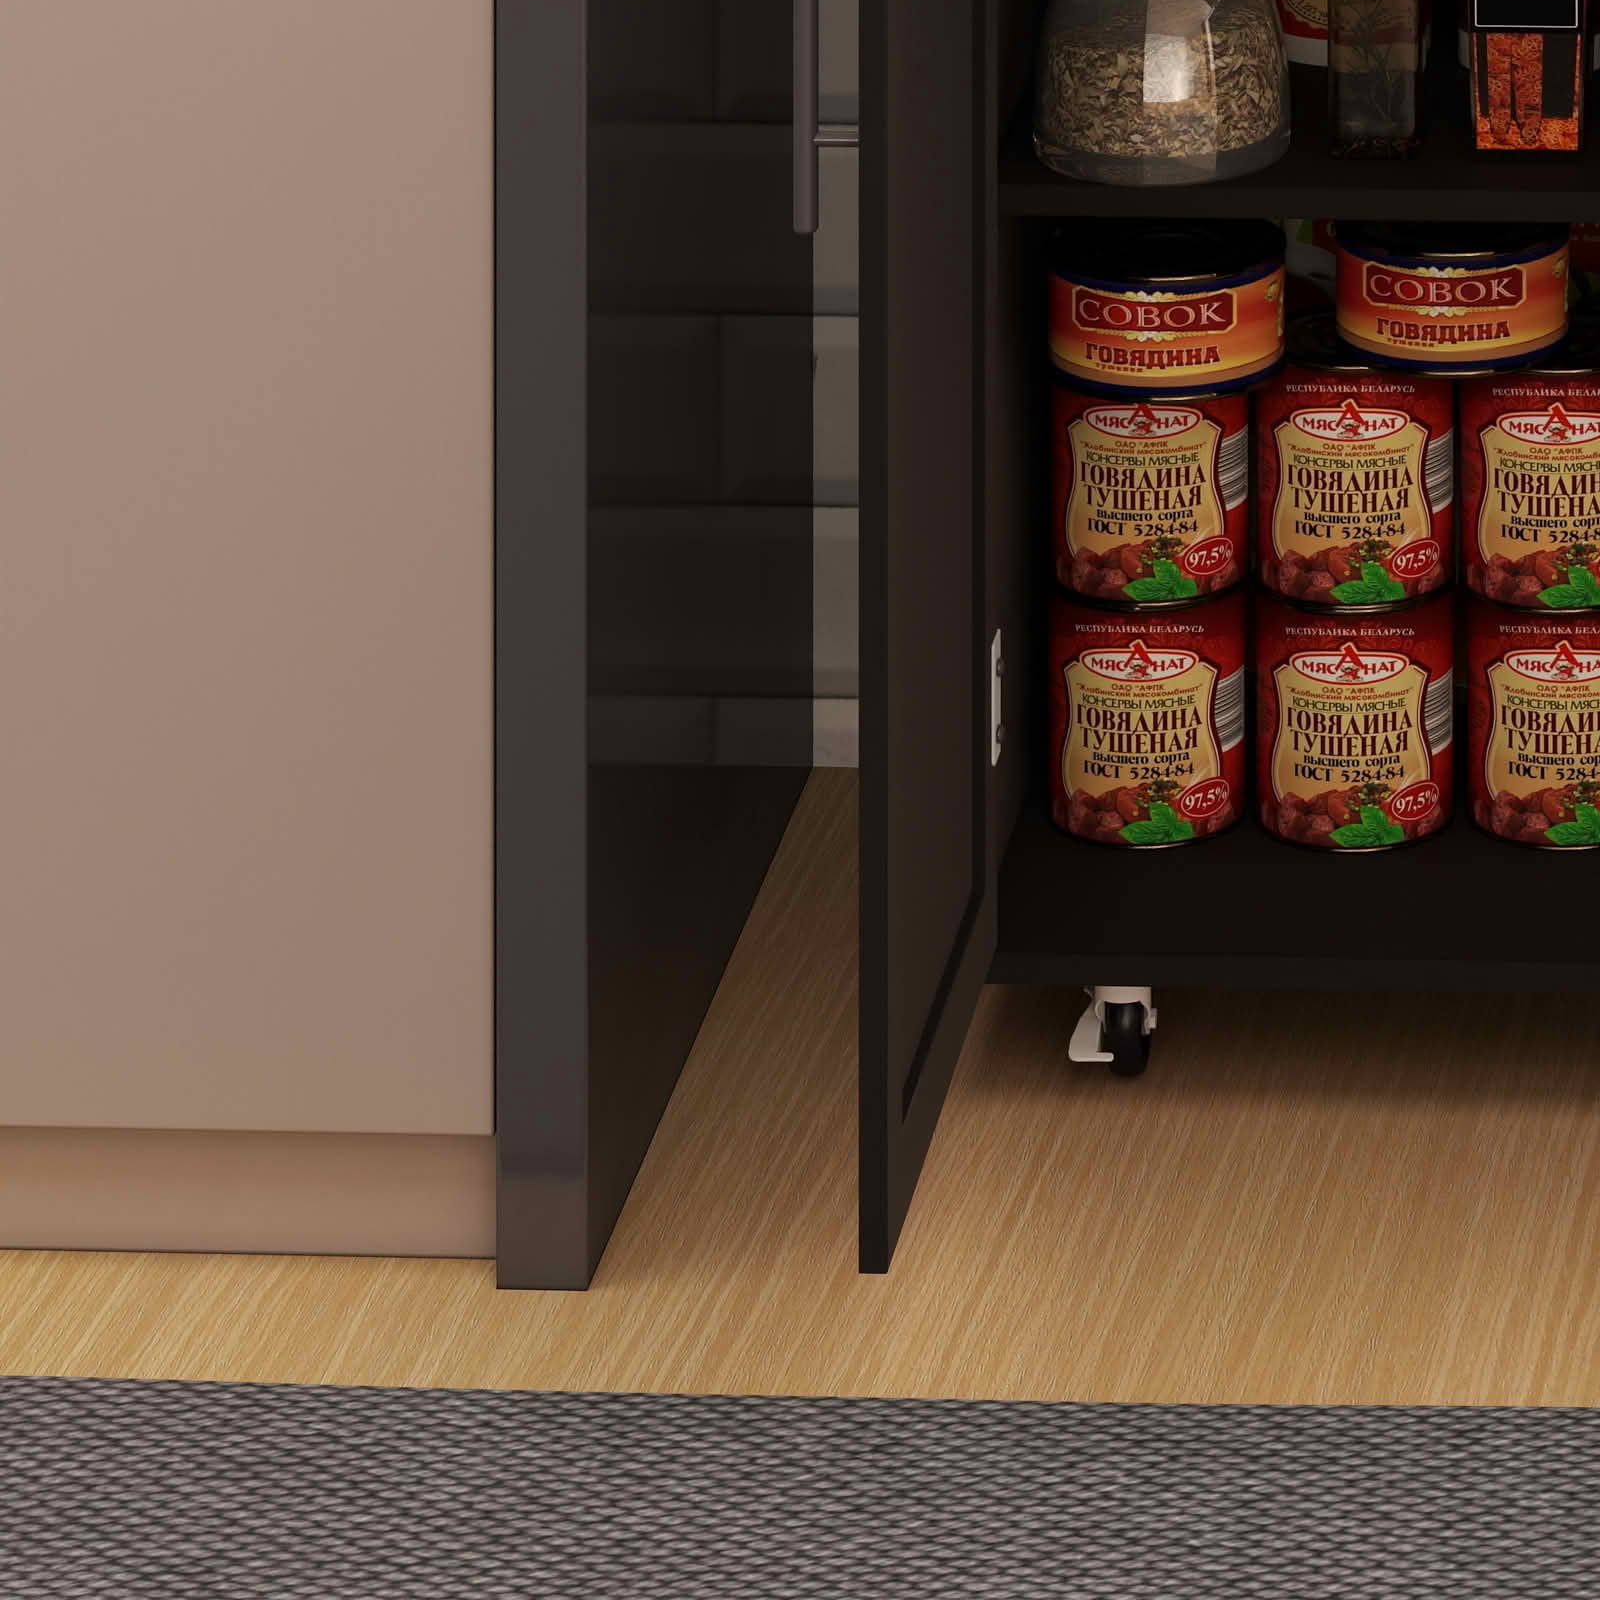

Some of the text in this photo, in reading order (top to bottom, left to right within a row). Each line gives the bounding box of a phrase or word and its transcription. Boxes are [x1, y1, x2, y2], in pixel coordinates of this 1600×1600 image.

[1369, 274, 1518, 303] СОВОК
[1079, 298, 1226, 328] СОВОК
[1376, 317, 1511, 344] ГОВЯДИНА
[1085, 342, 1221, 369] ГОВЯДИНА
[1293, 453, 1407, 469] КОНСЕРВЫ МЯСНЫЕ
[1080, 461, 1205, 492] ГОВЯДИНА
[1288, 464, 1413, 494] ГОВЯДИНА
[1085, 484, 1201, 511] ТУШЕНАЯ
[1292, 486, 1409, 513] ТУШЕНАЯ
[1087, 518, 1197, 537] ГОСТ 5284-84
[1295, 520, 1405, 539] ГОСТ 5284-84
[1305, 512, 1400, 525] высшего сорта
[1502, 524, 1542, 542] ГОСТ
[1189, 543, 1231, 569] 97,5%
[1397, 546, 1438, 571] 97,5%
[1076, 704, 1201, 734] ГОВЯДИНА
[1287, 707, 1412, 738] ГОВЯДИНА
[1081, 727, 1197, 753] ТУШЕНАЯ
[1291, 730, 1408, 756] ТУШЕНАЯ
[1084, 760, 1193, 779] ГОСТ 5284-84
[1509, 761, 1549, 779] ГОСТ
[1519, 753, 1574, 765] высшего
[1294, 763, 1404, 782] ГОСТ 5284-84
[1185, 786, 1227, 811] 97,5%
[1396, 789, 1438, 814] 97,5%
